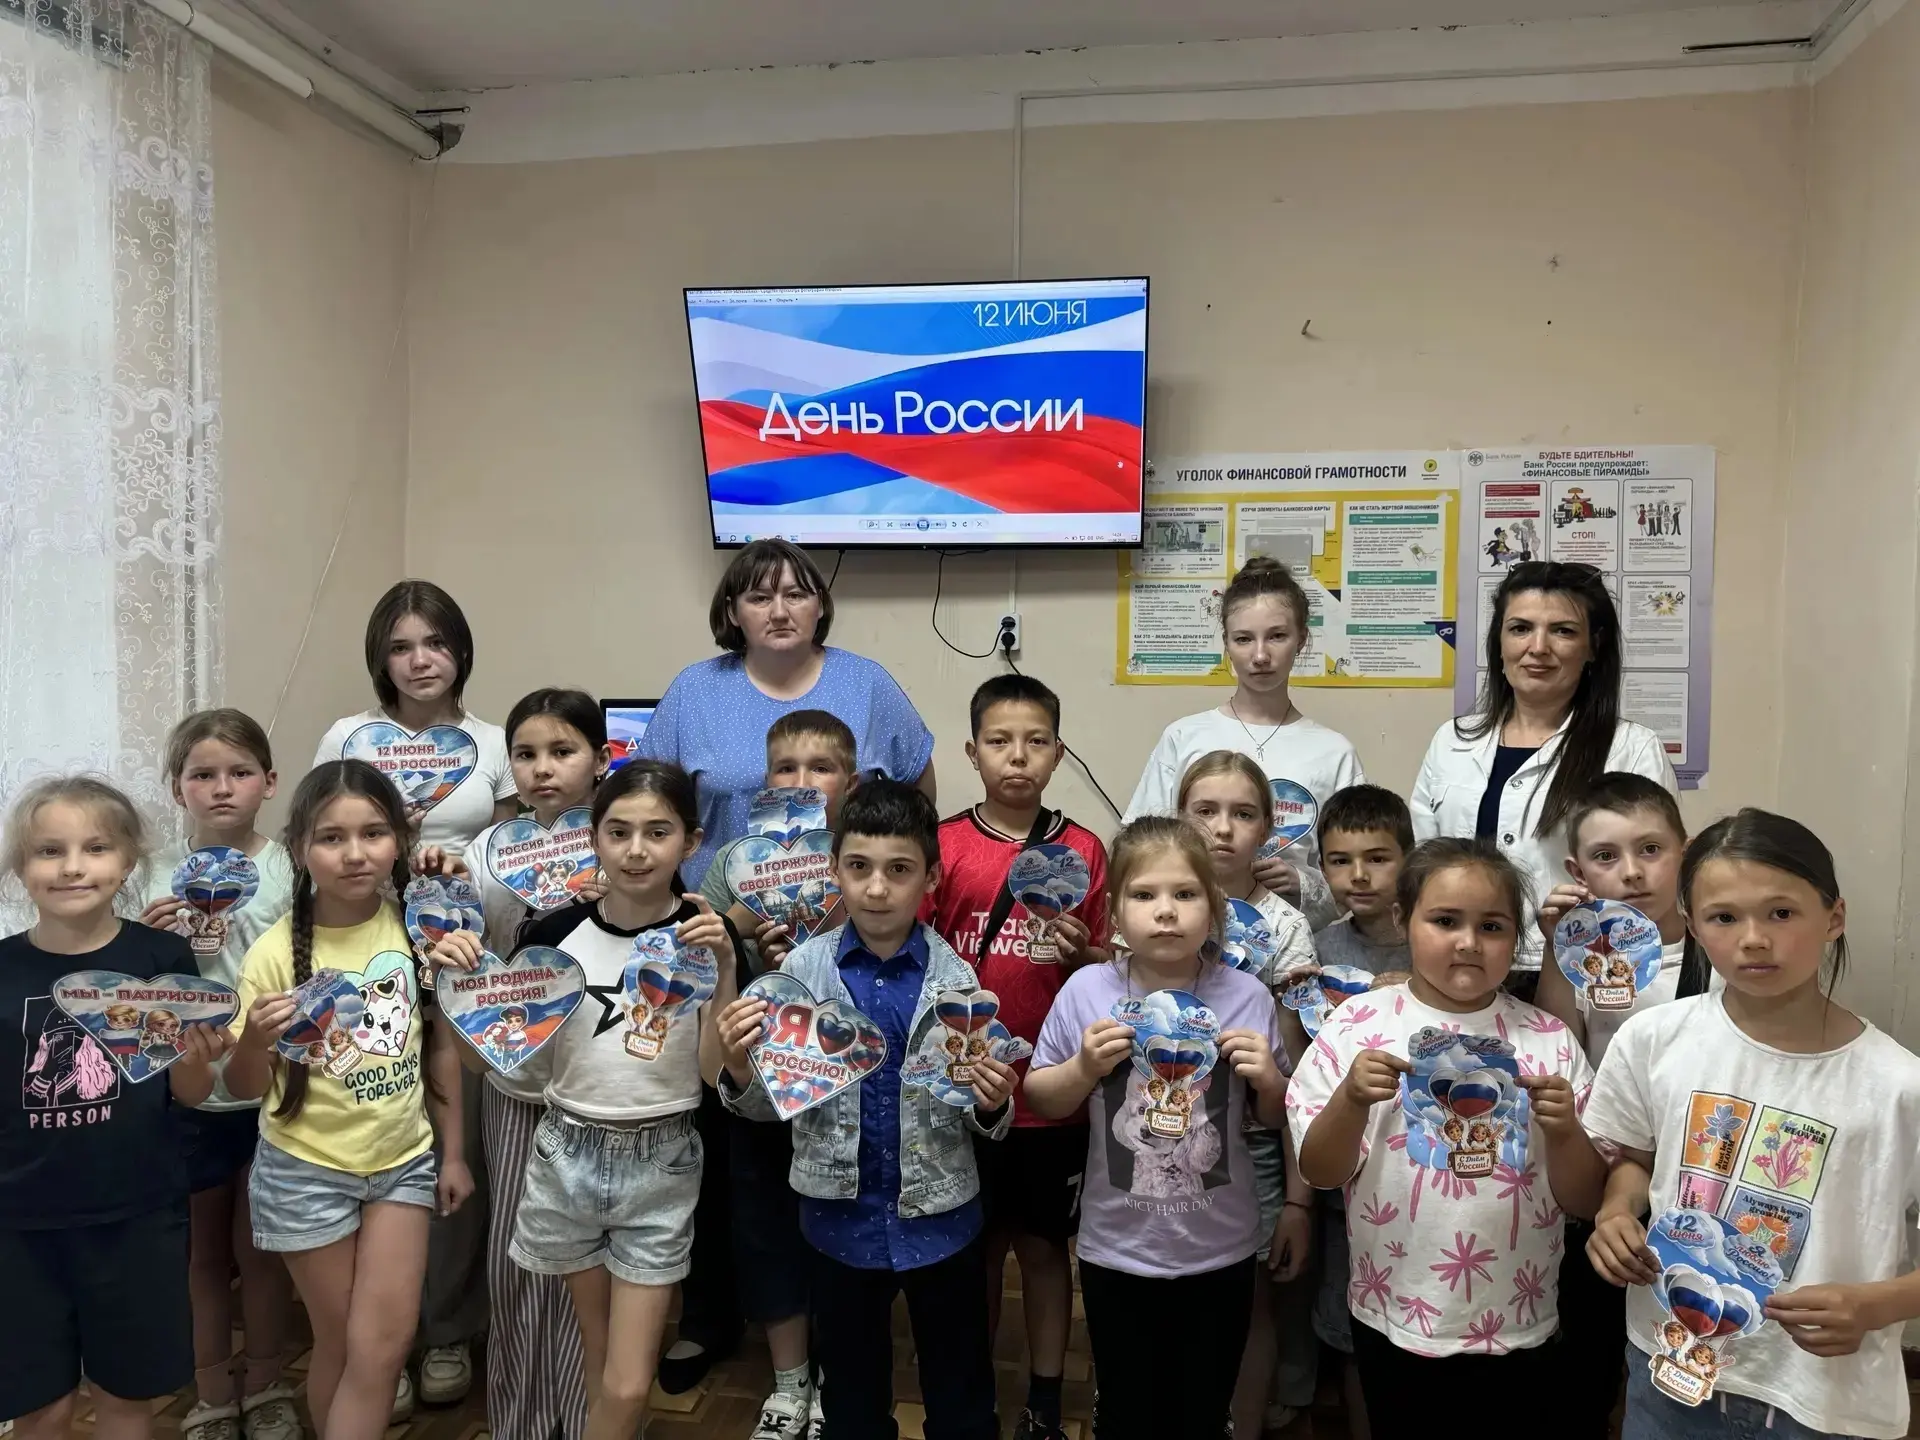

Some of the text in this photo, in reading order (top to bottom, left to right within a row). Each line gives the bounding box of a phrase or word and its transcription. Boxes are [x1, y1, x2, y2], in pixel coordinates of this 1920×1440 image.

[973, 300, 1087, 327] 12 ИЮНЯ
[759, 391, 1084, 442] День России
[1539, 450, 1634, 460] БУДЬТЕ БДИТЕЛЬНЫ!
[1522, 468, 1650, 477] «ФИНАНСОВЫЕ ПИРАМИДЫ»
[1524, 461, 1544, 469] Банк
[1579, 460, 1649, 469] предупреждает:
[1176, 469, 1223, 481] УГОЛОК
[1227, 465, 1311, 480] ФИНАНСОВОЙ
[1315, 466, 1407, 479] ГРАМОТНОСТИ
[377, 745, 435, 757] 12 ИЮНЯ
[369, 757, 461, 770] ЕНЬ РОССИИ!
[802, 790, 817, 800] 12
[498, 828, 592, 858] РОССИЯ ВЕЛИК
[497, 840, 592, 870] И МОГУЧАЯ СТРА
[1060, 856, 1075, 867] 12
[188, 857, 201, 872] 12
[754, 854, 826, 874] Я ГОРЖУСЬ
[739, 867, 831, 893] СВОЕЙ СТРАНО
[456, 884, 471, 895] 12
[1253, 930, 1271, 943] 12
[1565, 920, 1585, 937] 12
[647, 935, 666, 948] 12
[1617, 928, 1652, 949] Россию!
[453, 967, 556, 993] МОЯ РОДИНА
[61, 988, 233, 1003] МЫ ПАТРИОТЫ!
[476, 986, 547, 1008] РОССИЯ!
[1293, 986, 1309, 999] 12
[1123, 1001, 1141, 1014] 12
[772, 1005, 812, 1048] Я
[1181, 1022, 1215, 1035] Россию!
[1005, 1040, 1020, 1055] 12
[1417, 1037, 1453, 1059] Россию!
[1479, 1038, 1502, 1049] 12
[344, 1052, 419, 1090] GOOD DAYS
[761, 1050, 846, 1081] РОССИЮ!
[906, 1067, 940, 1080] Россию!
[355, 1072, 416, 1105] FOREVER
[30, 1105, 112, 1129] PERSON
[1154, 1119, 1182, 1129] России!
[1783, 1126, 1825, 1145] FLOWER
[1803, 1123, 1820, 1135] Like
[1721, 1140, 1735, 1170] BLOOM
[1457, 1159, 1490, 1170] России!
[1124, 1195, 1215, 1216] NICE HAIR DAY
[1781, 1206, 1803, 1219] keep
[1674, 1214, 1697, 1231] 12
[1749, 1206, 1791, 1223] growing
[1668, 1229, 1704, 1242] июня
[1750, 1245, 1766, 1257] Я
[1725, 1248, 1776, 1281] Россию!
[1661, 1369, 1701, 1397] России!
[1673, 1368, 1698, 1387] Днём
